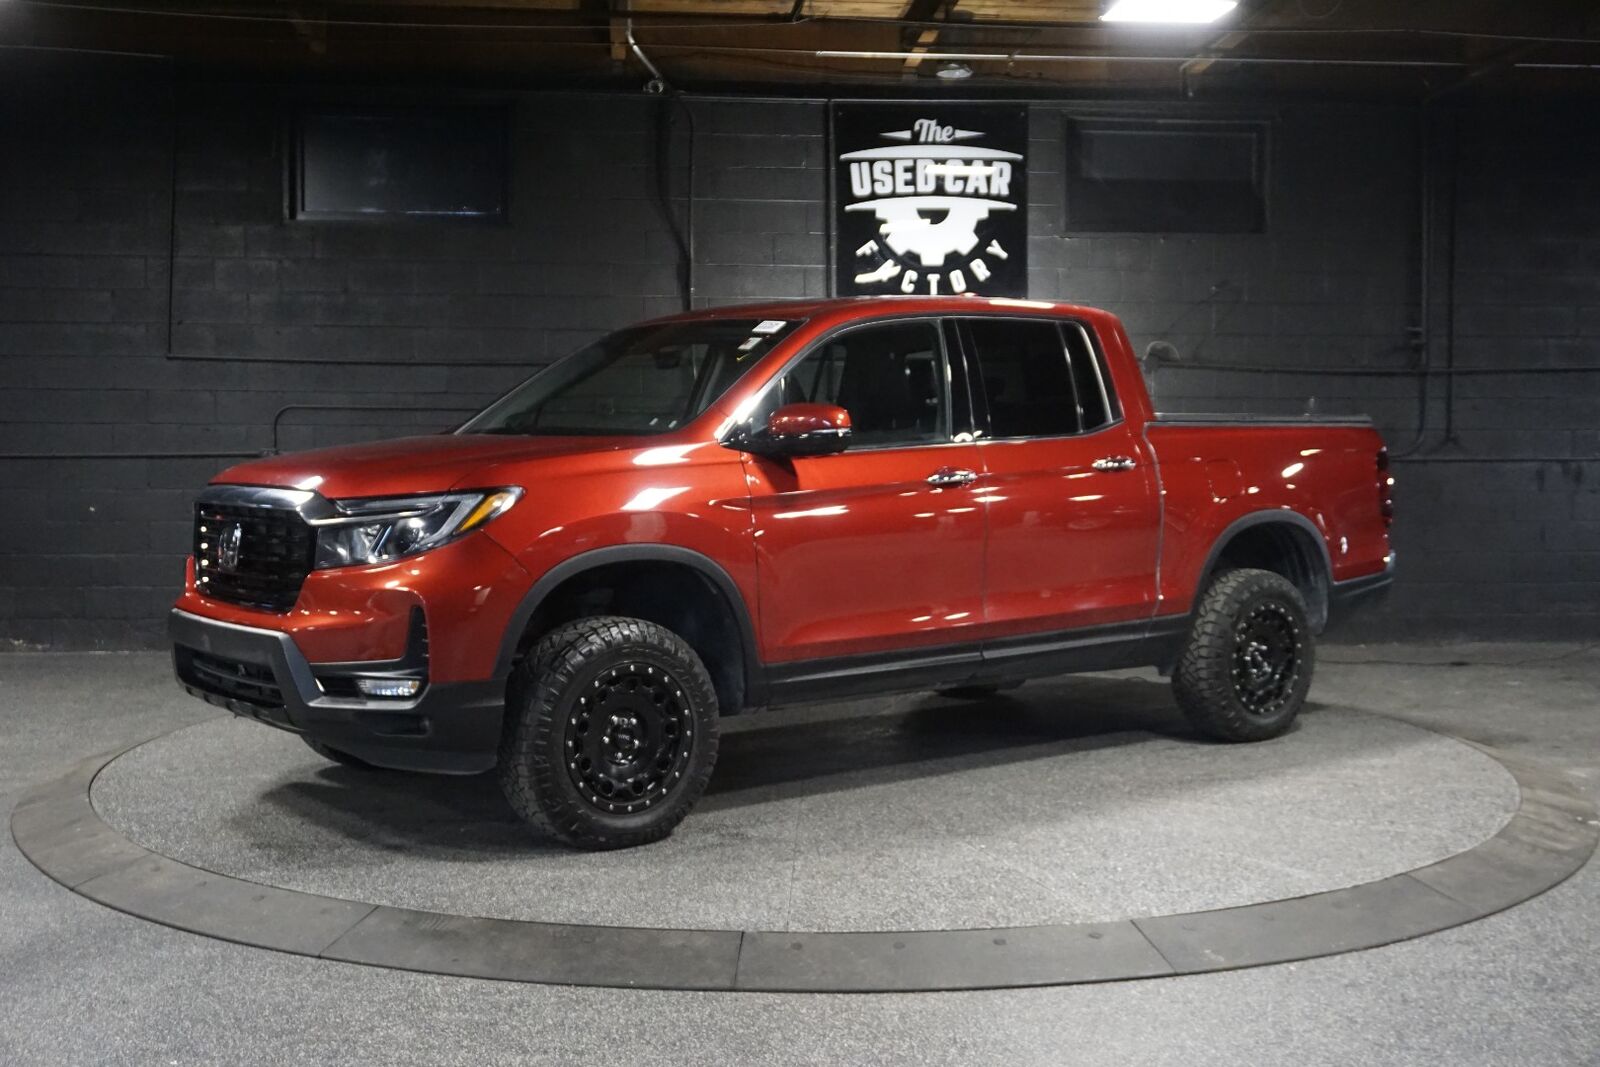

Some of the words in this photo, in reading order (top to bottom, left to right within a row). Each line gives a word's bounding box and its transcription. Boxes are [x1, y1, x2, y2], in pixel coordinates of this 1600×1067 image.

[914, 118, 954, 143] The
[850, 159, 936, 197] USED
[944, 159, 1012, 195] CAR
